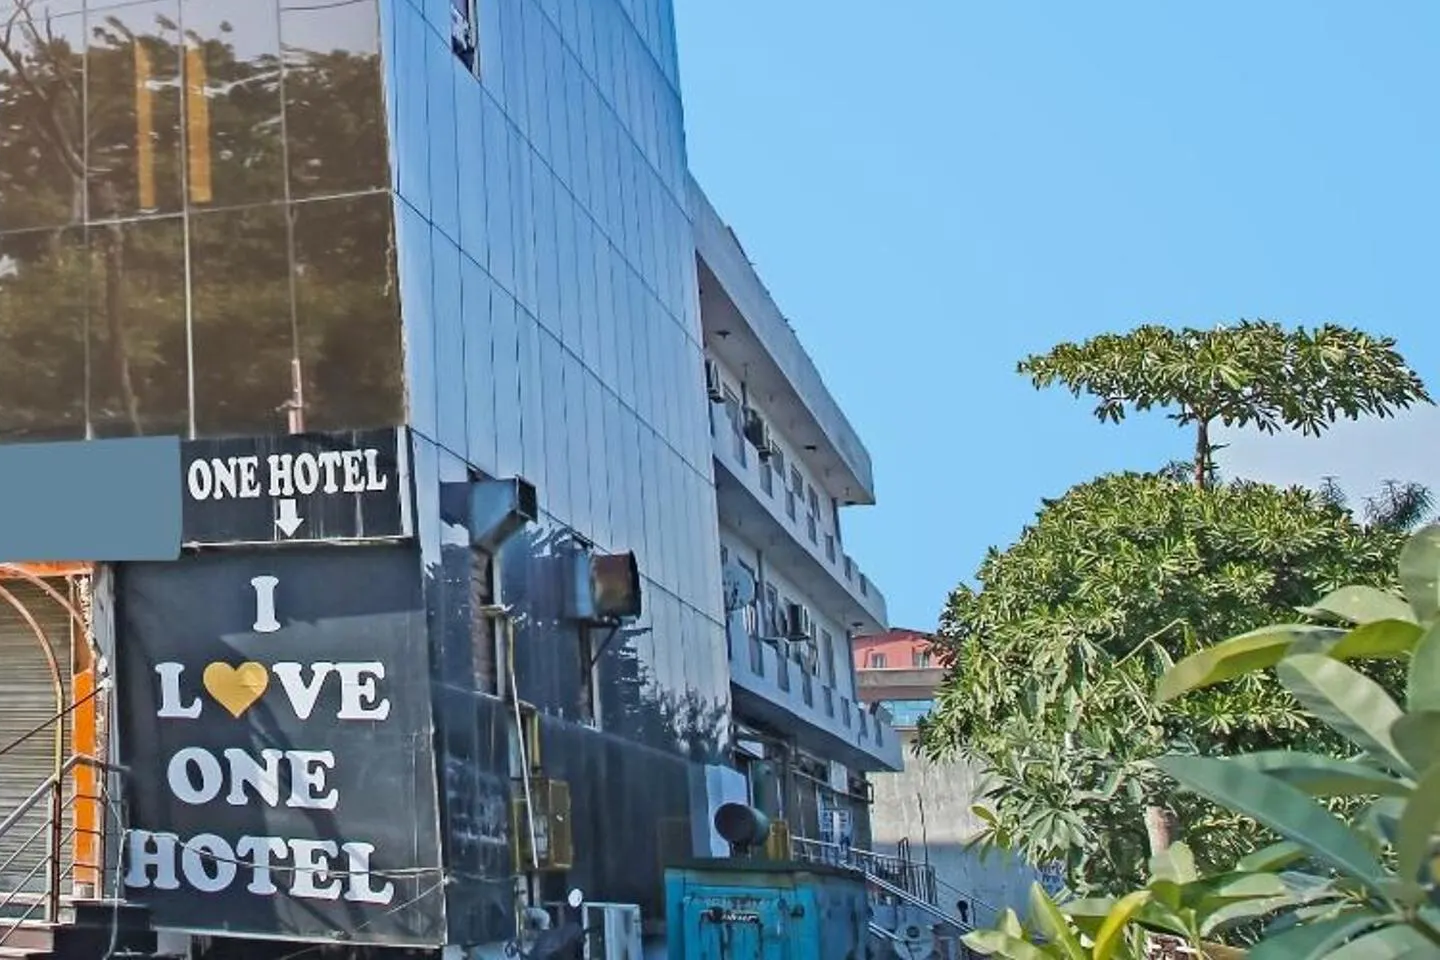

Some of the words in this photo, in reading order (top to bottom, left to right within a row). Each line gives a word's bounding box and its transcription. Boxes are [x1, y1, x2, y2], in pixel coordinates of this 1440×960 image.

[187, 456, 260, 500] ONE
[267, 448, 388, 496] HOTEL
[251, 575, 281, 633] I
[167, 746, 339, 810] ONE
[124, 829, 395, 905] HOTEL
